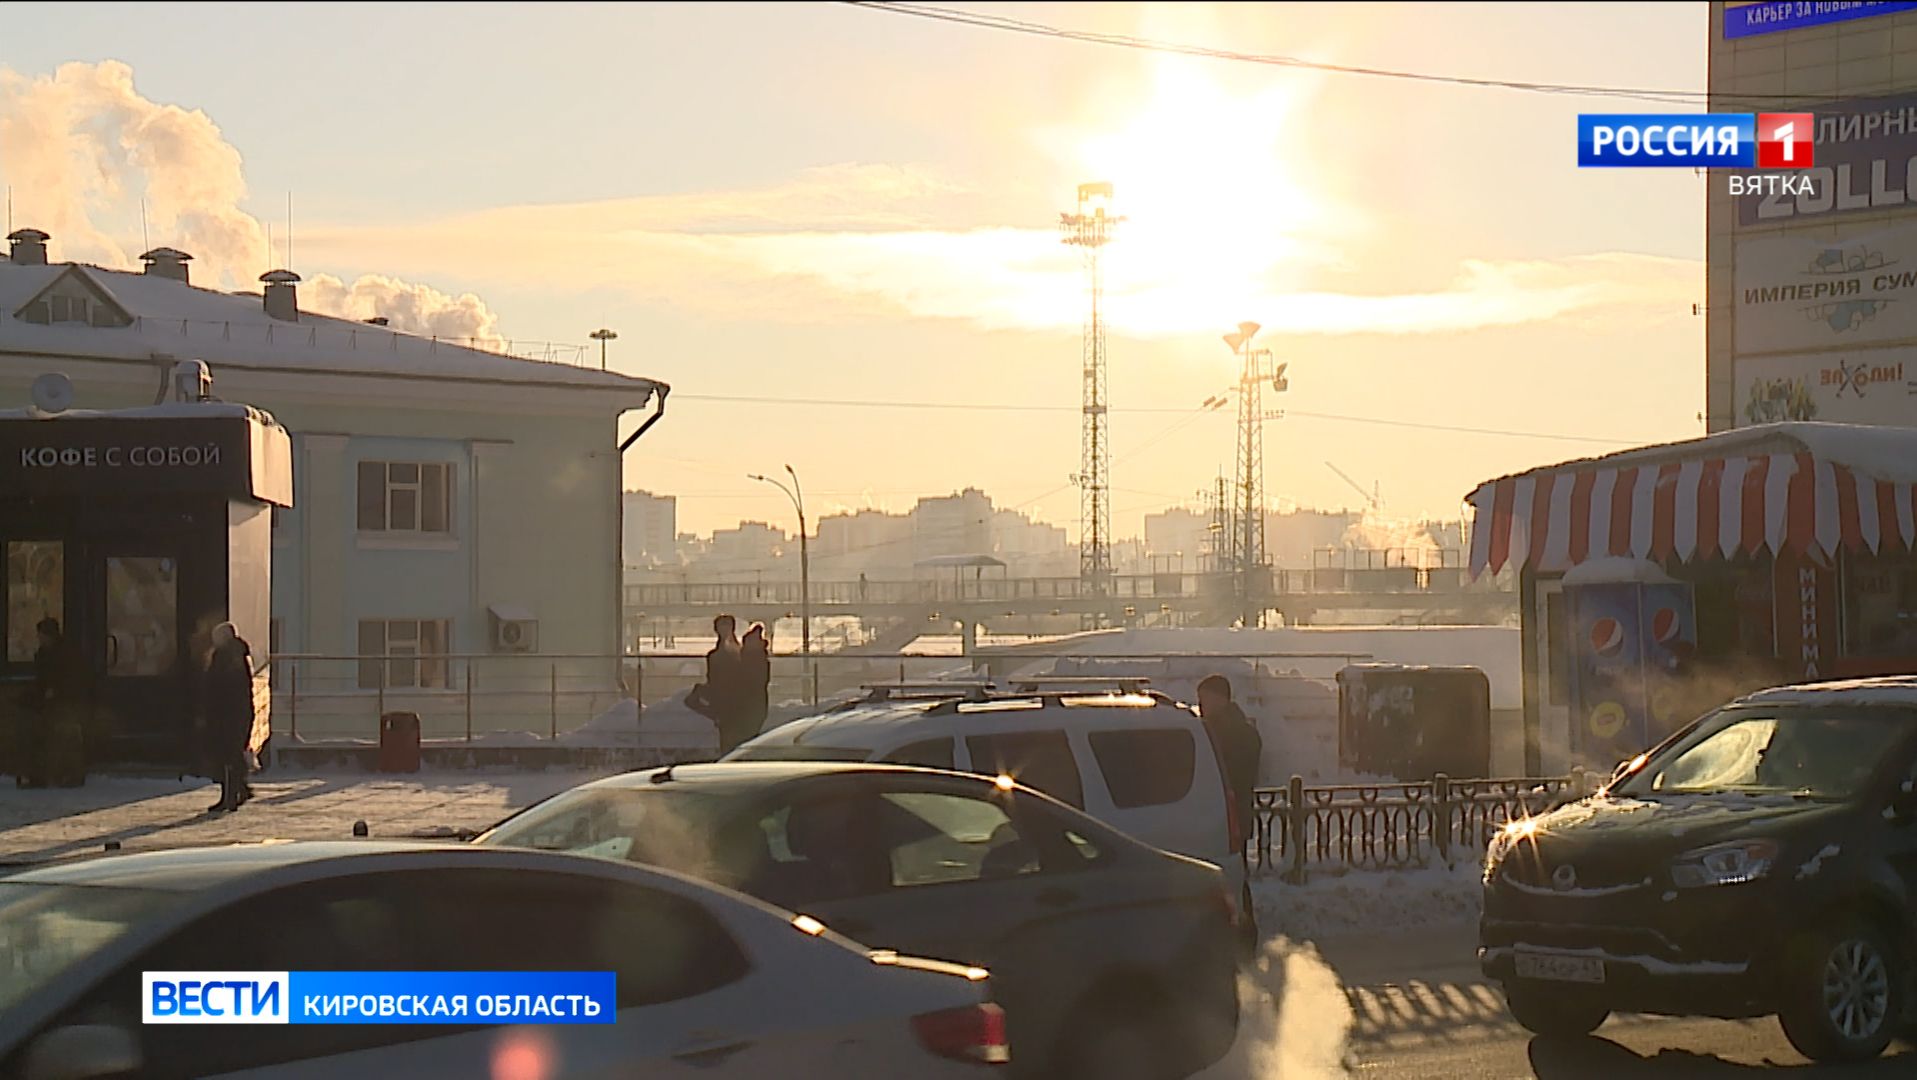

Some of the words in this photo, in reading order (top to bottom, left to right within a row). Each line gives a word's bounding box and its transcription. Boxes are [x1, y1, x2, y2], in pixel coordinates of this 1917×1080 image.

[1746, 3, 1792, 25] КАРЬЕР
[1796, 1, 1811, 17] ЗА
[1815, 107, 1917, 145] ЛИРН
[1745, 279, 1860, 304] ИМПЕРИЯ
[21, 447, 97, 467] КОФЕ
[105, 447, 121, 466] С
[130, 442, 220, 466] СОБОЙ
